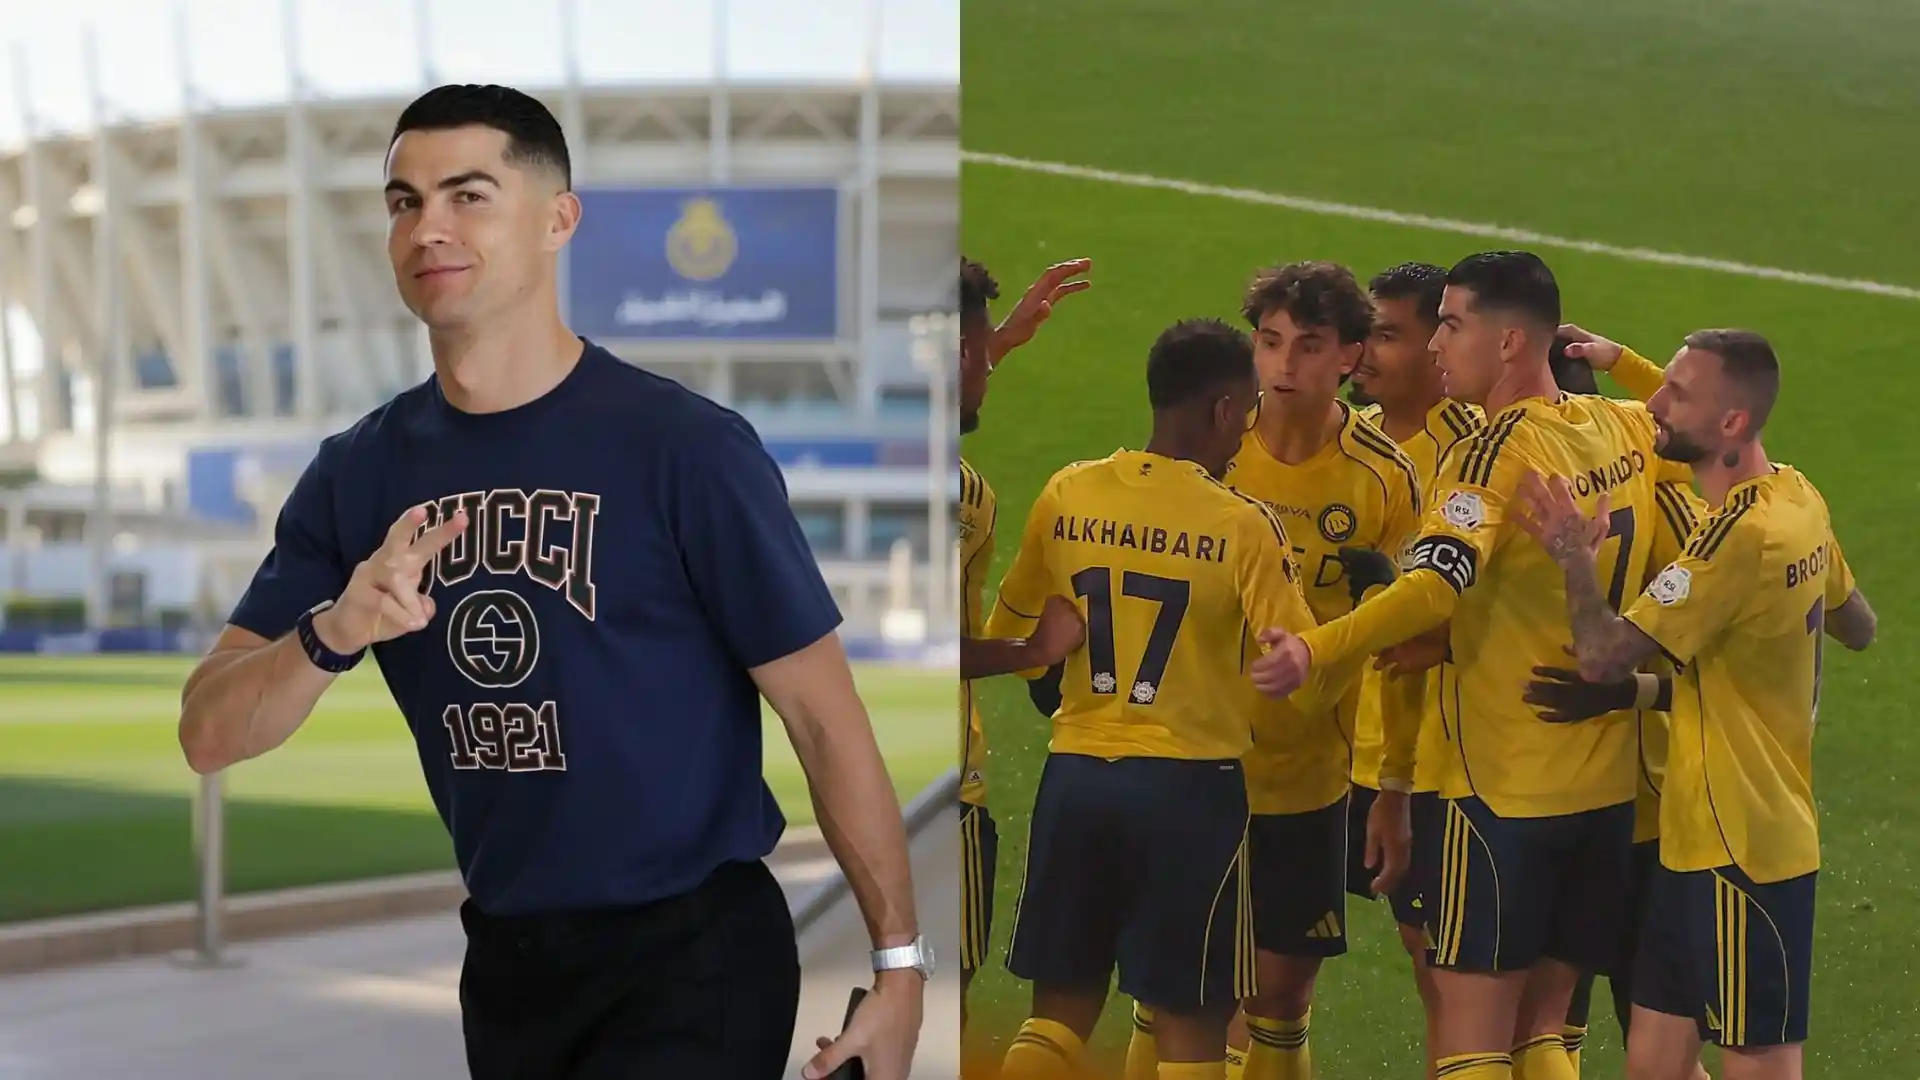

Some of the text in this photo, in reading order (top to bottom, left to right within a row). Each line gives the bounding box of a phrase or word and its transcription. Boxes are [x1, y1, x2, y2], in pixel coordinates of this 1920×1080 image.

[1053, 515, 1227, 563] ALKHAIBARI
[1592, 506, 1634, 616] 7
[1786, 540, 1829, 588] BROZ
[1070, 566, 1191, 704] 17
[442, 701, 567, 771] 1921
